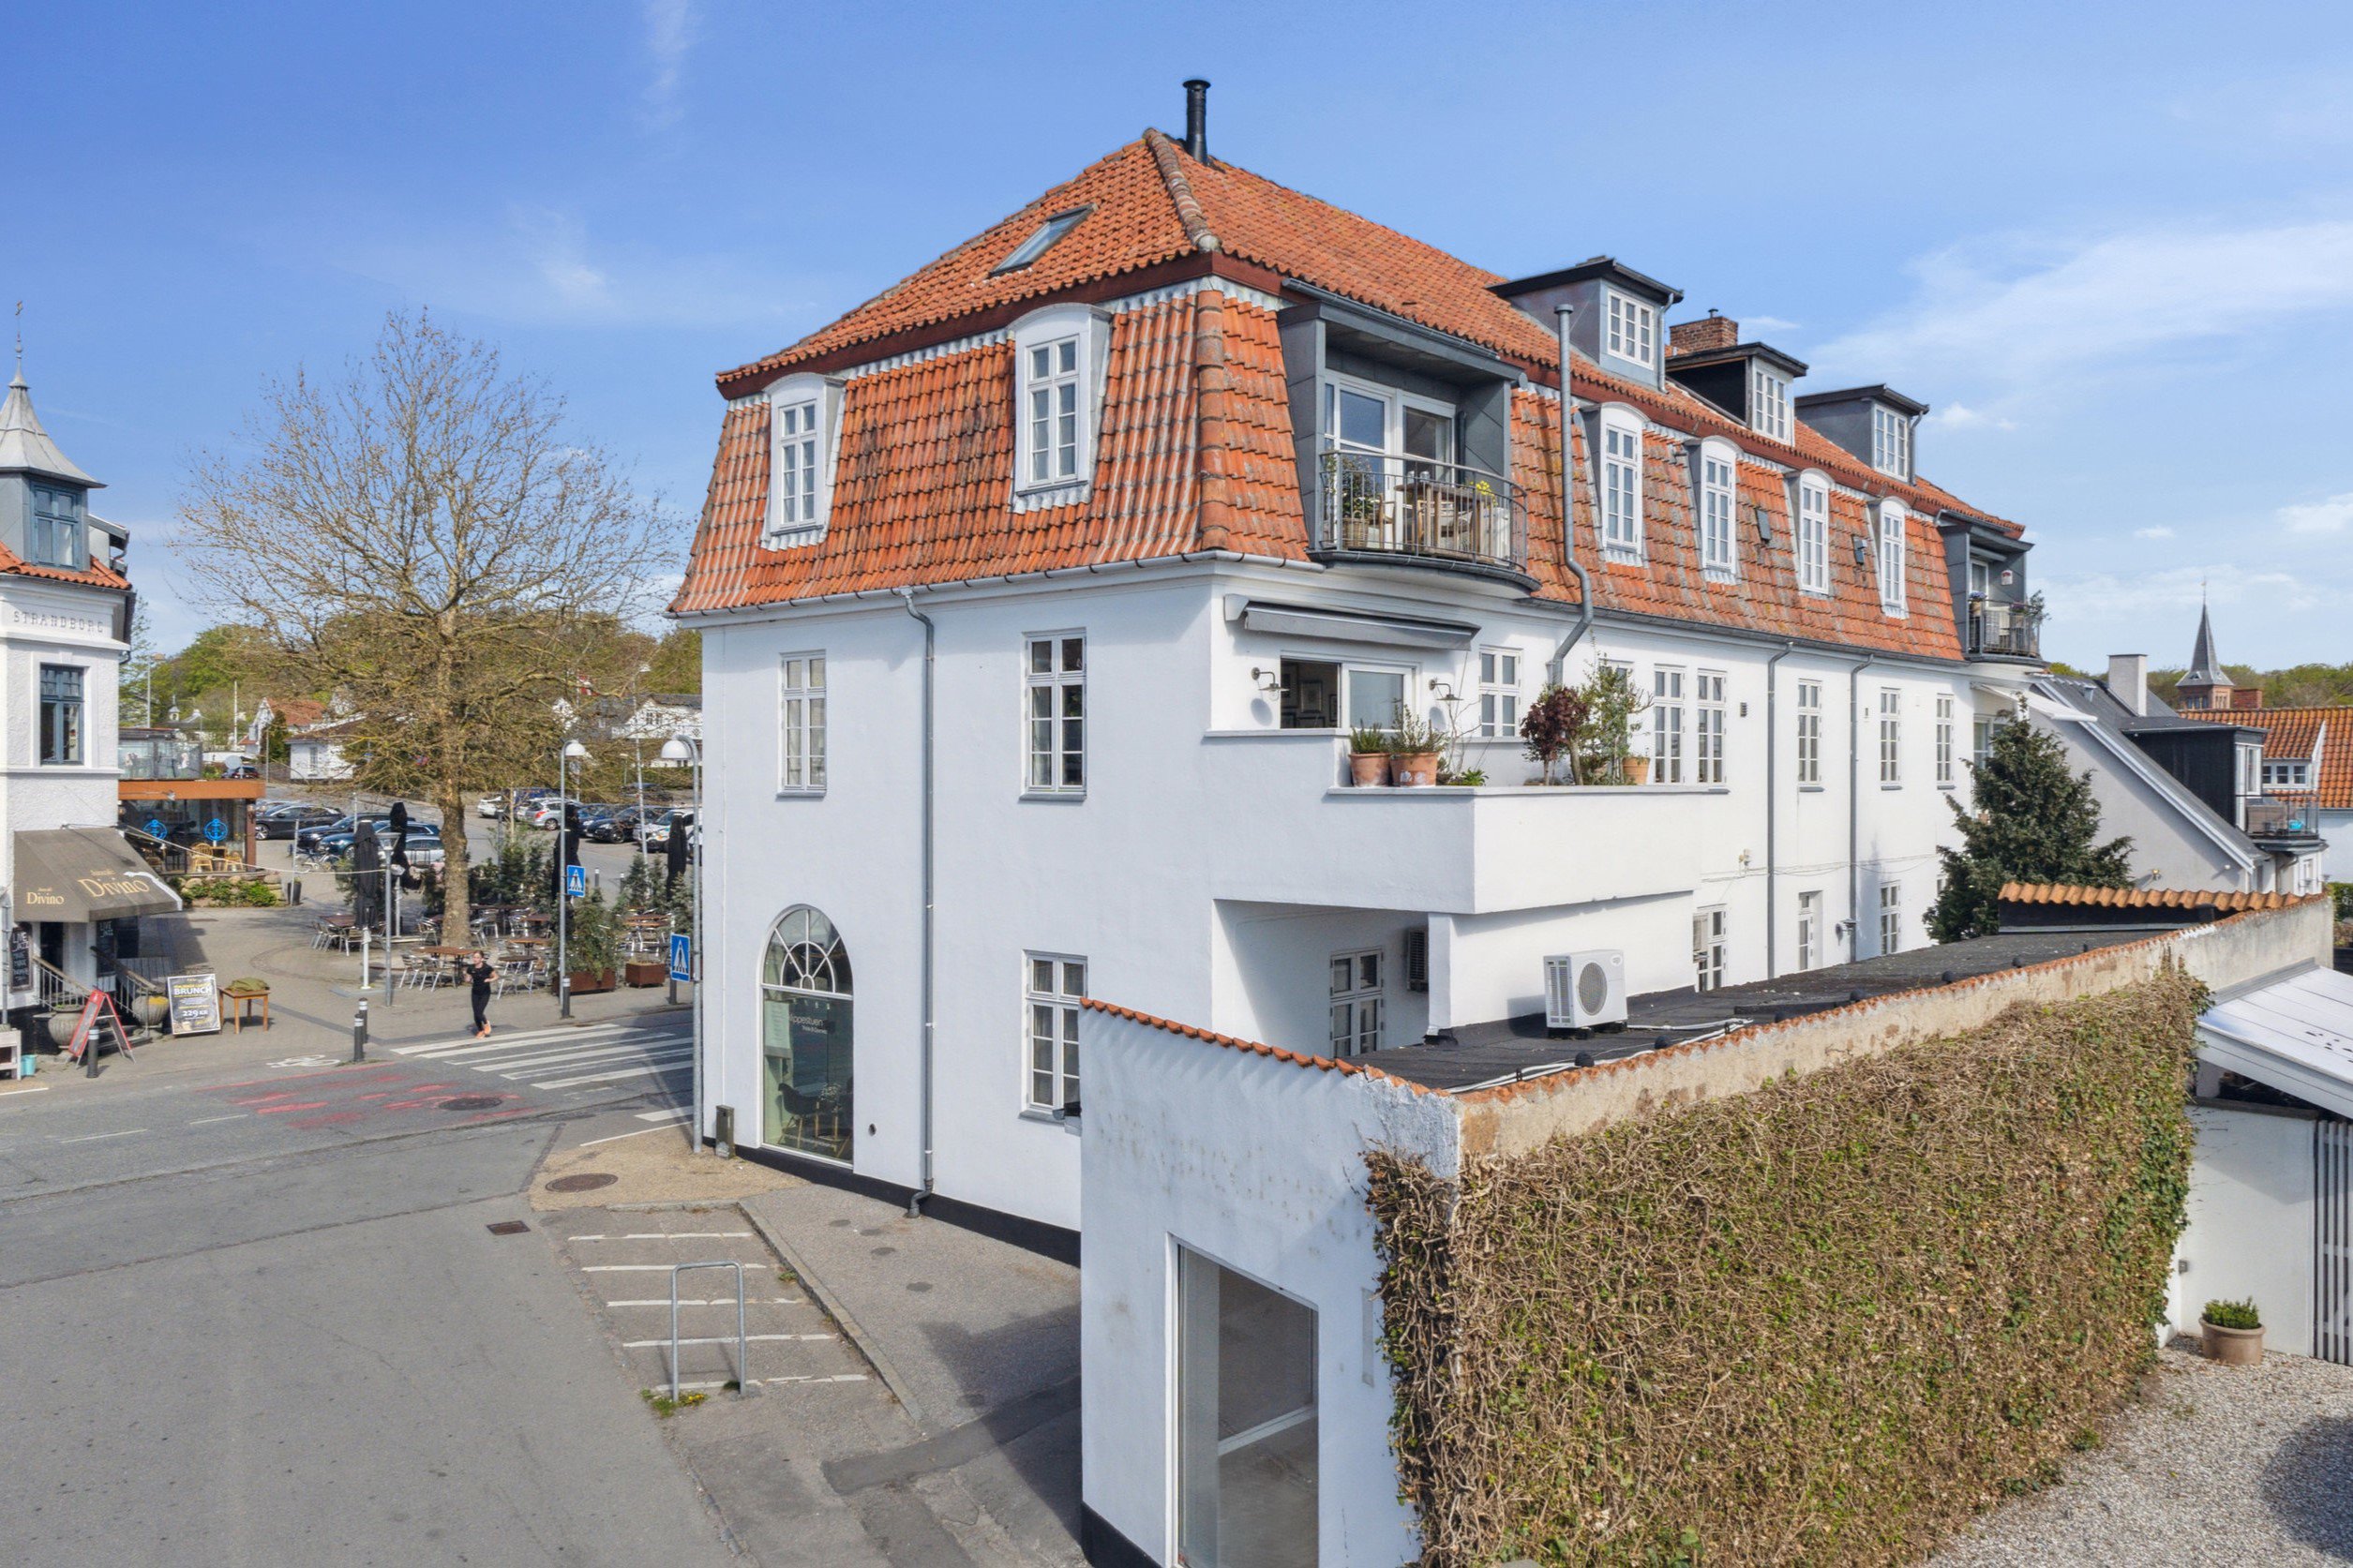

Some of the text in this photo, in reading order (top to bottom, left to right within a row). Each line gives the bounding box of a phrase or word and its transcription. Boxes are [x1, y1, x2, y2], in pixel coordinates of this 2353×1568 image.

[13, 610, 104, 633] STRANDBORG
[77, 878, 150, 897] Divino
[26, 891, 65, 904] Divino
[173, 985, 213, 994] BRUNCH
